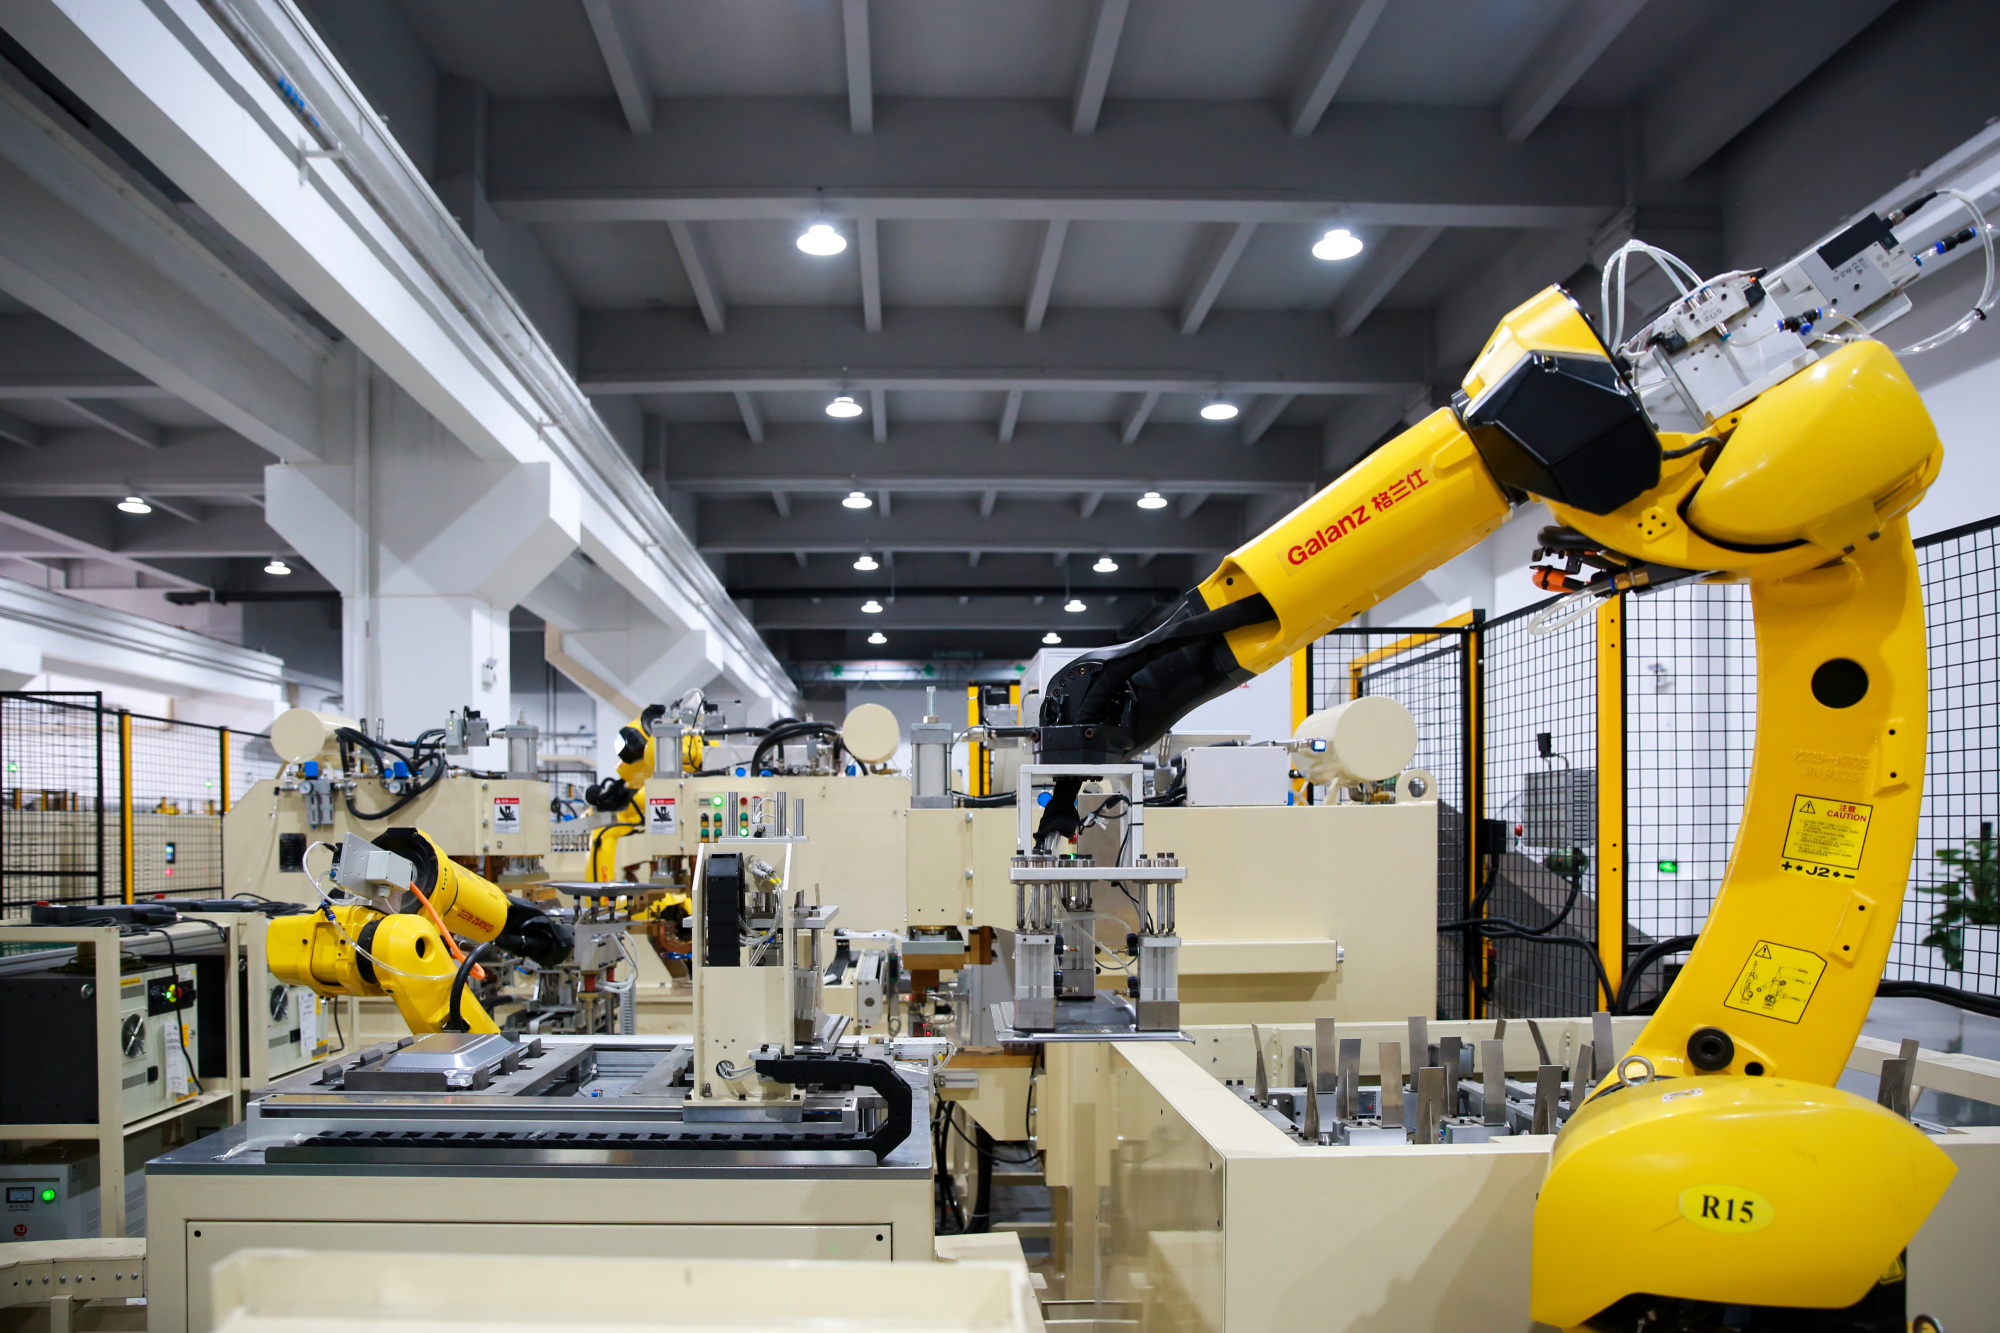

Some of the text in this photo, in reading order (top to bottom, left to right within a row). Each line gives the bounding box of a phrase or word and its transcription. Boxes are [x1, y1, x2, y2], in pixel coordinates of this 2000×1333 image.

[1287, 468, 1429, 566] Galanz 格兰仕
[1826, 810, 1867, 822] CAUTION
[1805, 866, 1830, 878] J2
[1700, 1194, 1754, 1224] R15
